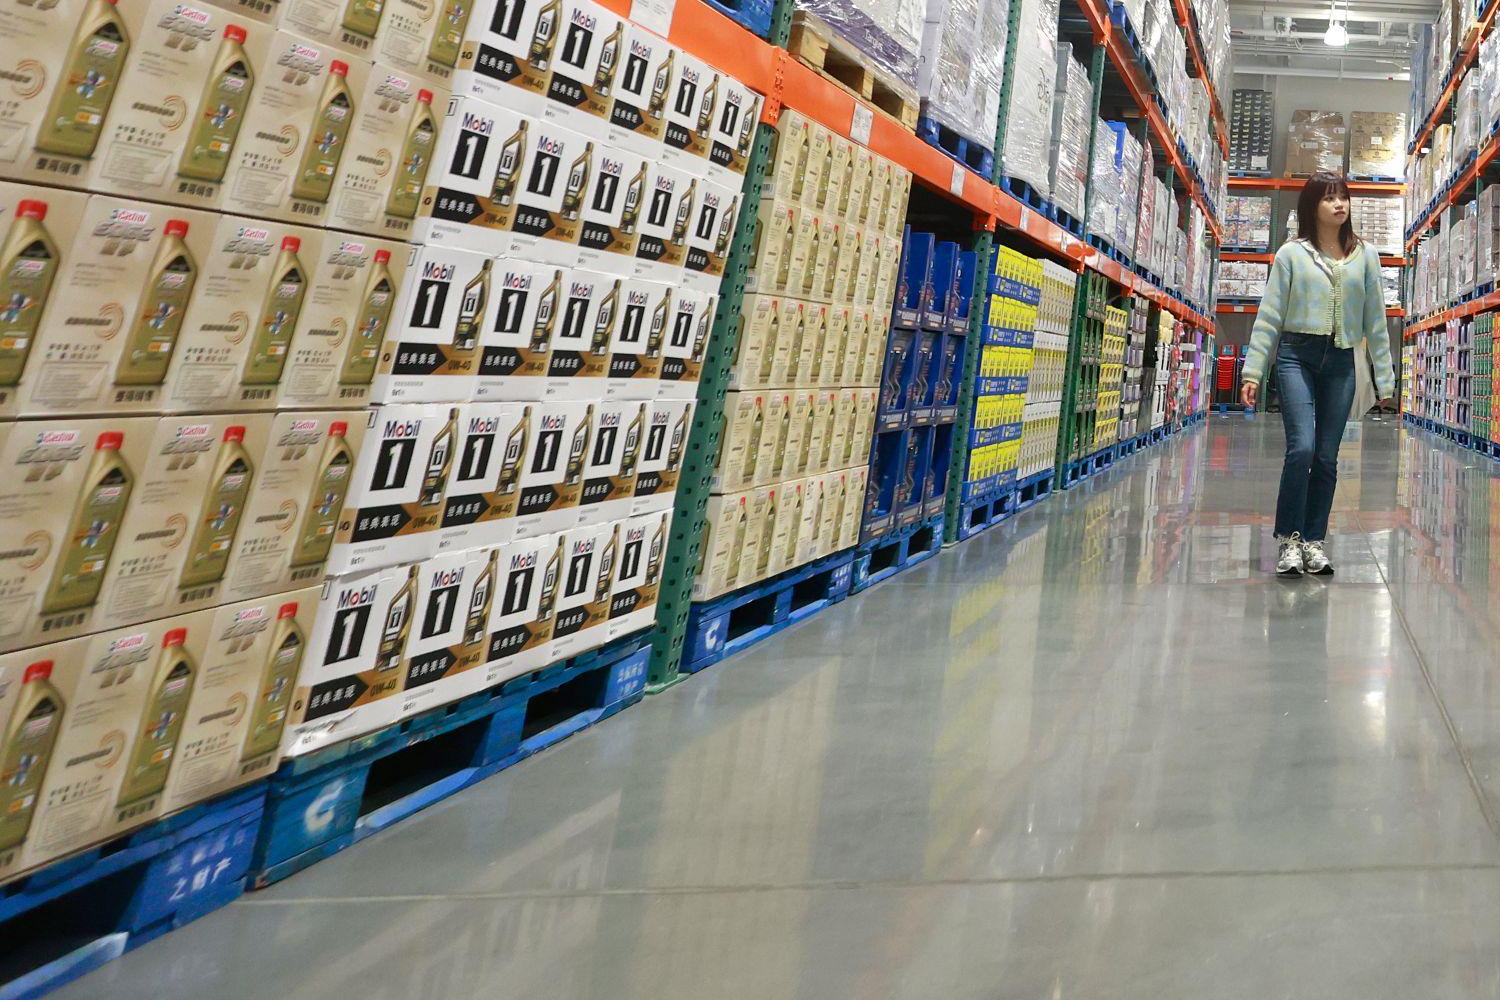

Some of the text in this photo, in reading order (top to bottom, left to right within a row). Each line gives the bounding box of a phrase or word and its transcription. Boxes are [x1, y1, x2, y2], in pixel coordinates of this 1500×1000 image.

[571, 7, 597, 29] Mobil
[462, 112, 493, 133] Mobil
[422, 260, 455, 281] Mobil
[504, 272, 533, 290] Mobil
[628, 290, 649, 304] Mobil
[383, 419, 422, 438] Mobil
[469, 416, 499, 433] Mobil
[431, 566, 464, 589] Mobil
[338, 584, 378, 608] Mobil
